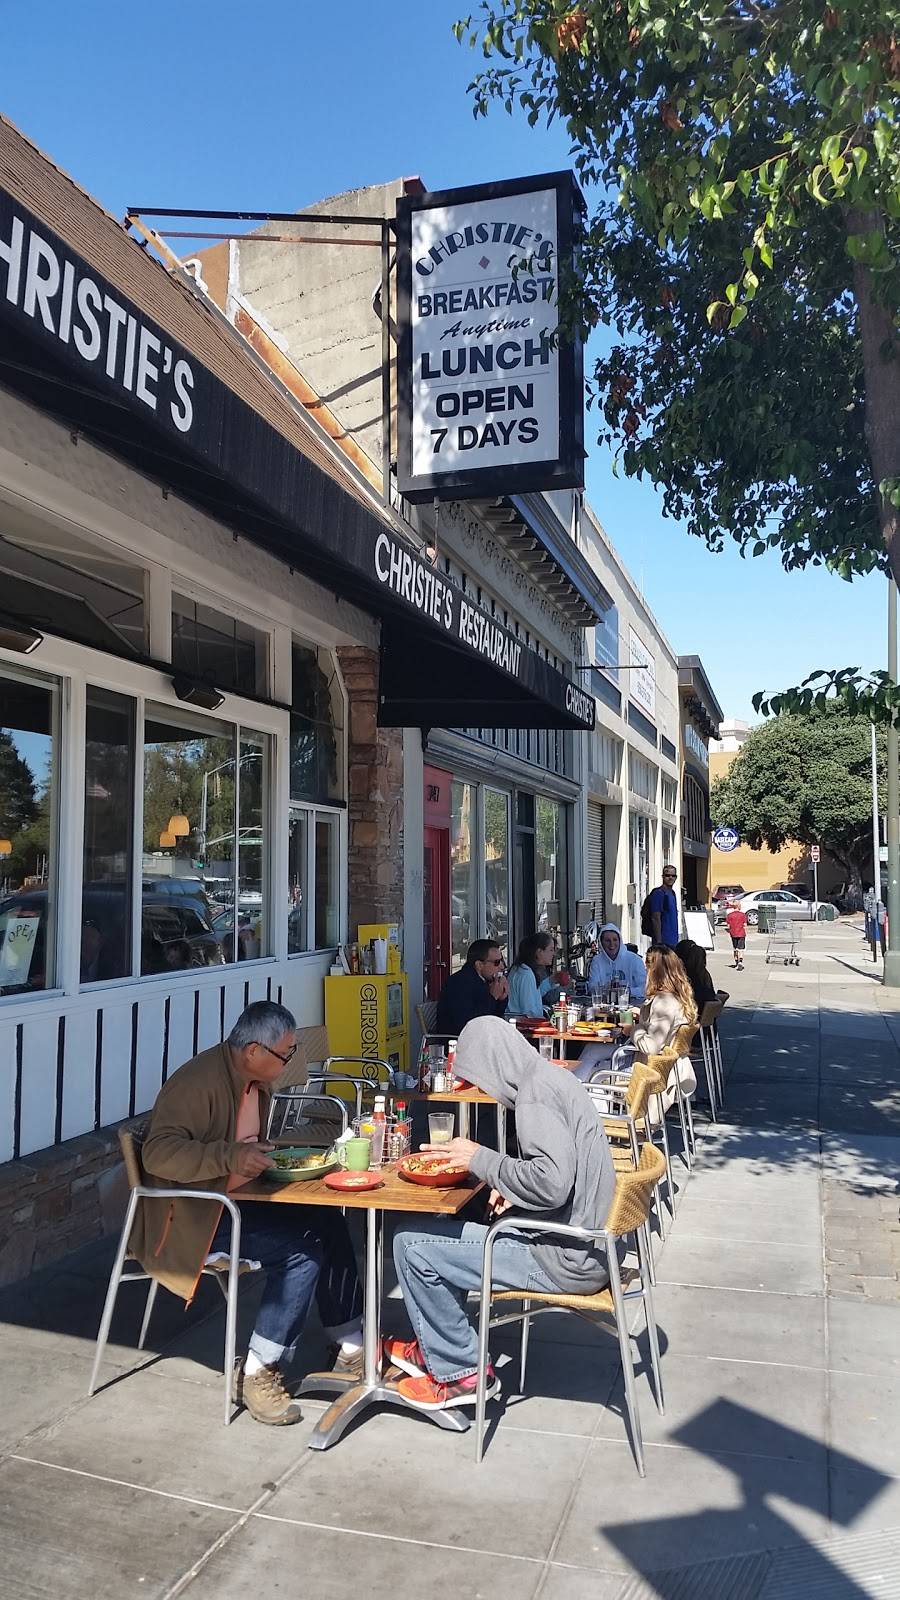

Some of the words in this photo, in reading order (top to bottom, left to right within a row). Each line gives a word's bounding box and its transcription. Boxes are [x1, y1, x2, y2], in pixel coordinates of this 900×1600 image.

[415, 222, 554, 276] CHRISTIE'S
[418, 278, 550, 318] BREAKFAST
[440, 316, 531, 340] Anytime
[421, 338, 549, 379] LUNCH
[436, 383, 534, 418] OPEN
[430, 429, 448, 453] 7
[458, 417, 539, 450] DAYS
[374, 533, 453, 629] CHRISTIE'S
[459, 601, 522, 678] RESTAURANT
[566, 684, 593, 725] CHRISTIE'S
